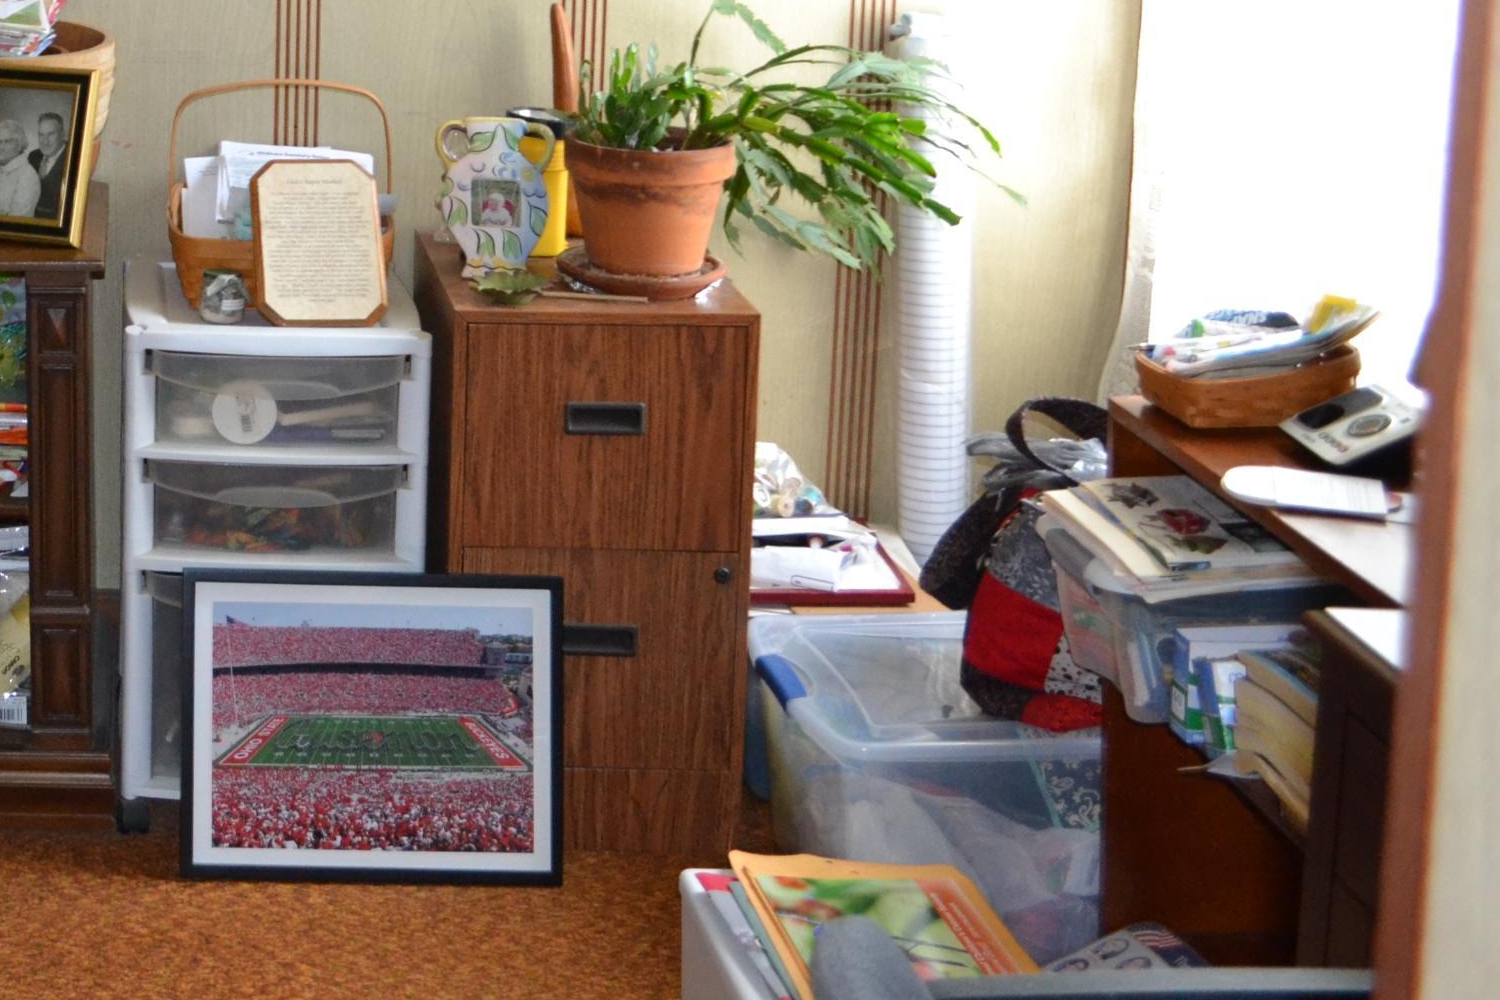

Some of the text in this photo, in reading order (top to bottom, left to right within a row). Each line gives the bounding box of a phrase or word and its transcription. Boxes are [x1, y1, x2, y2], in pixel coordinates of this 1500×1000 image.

[233, 717, 285, 760] OHIO STATE
[464, 721, 510, 760] BUCKEYES
